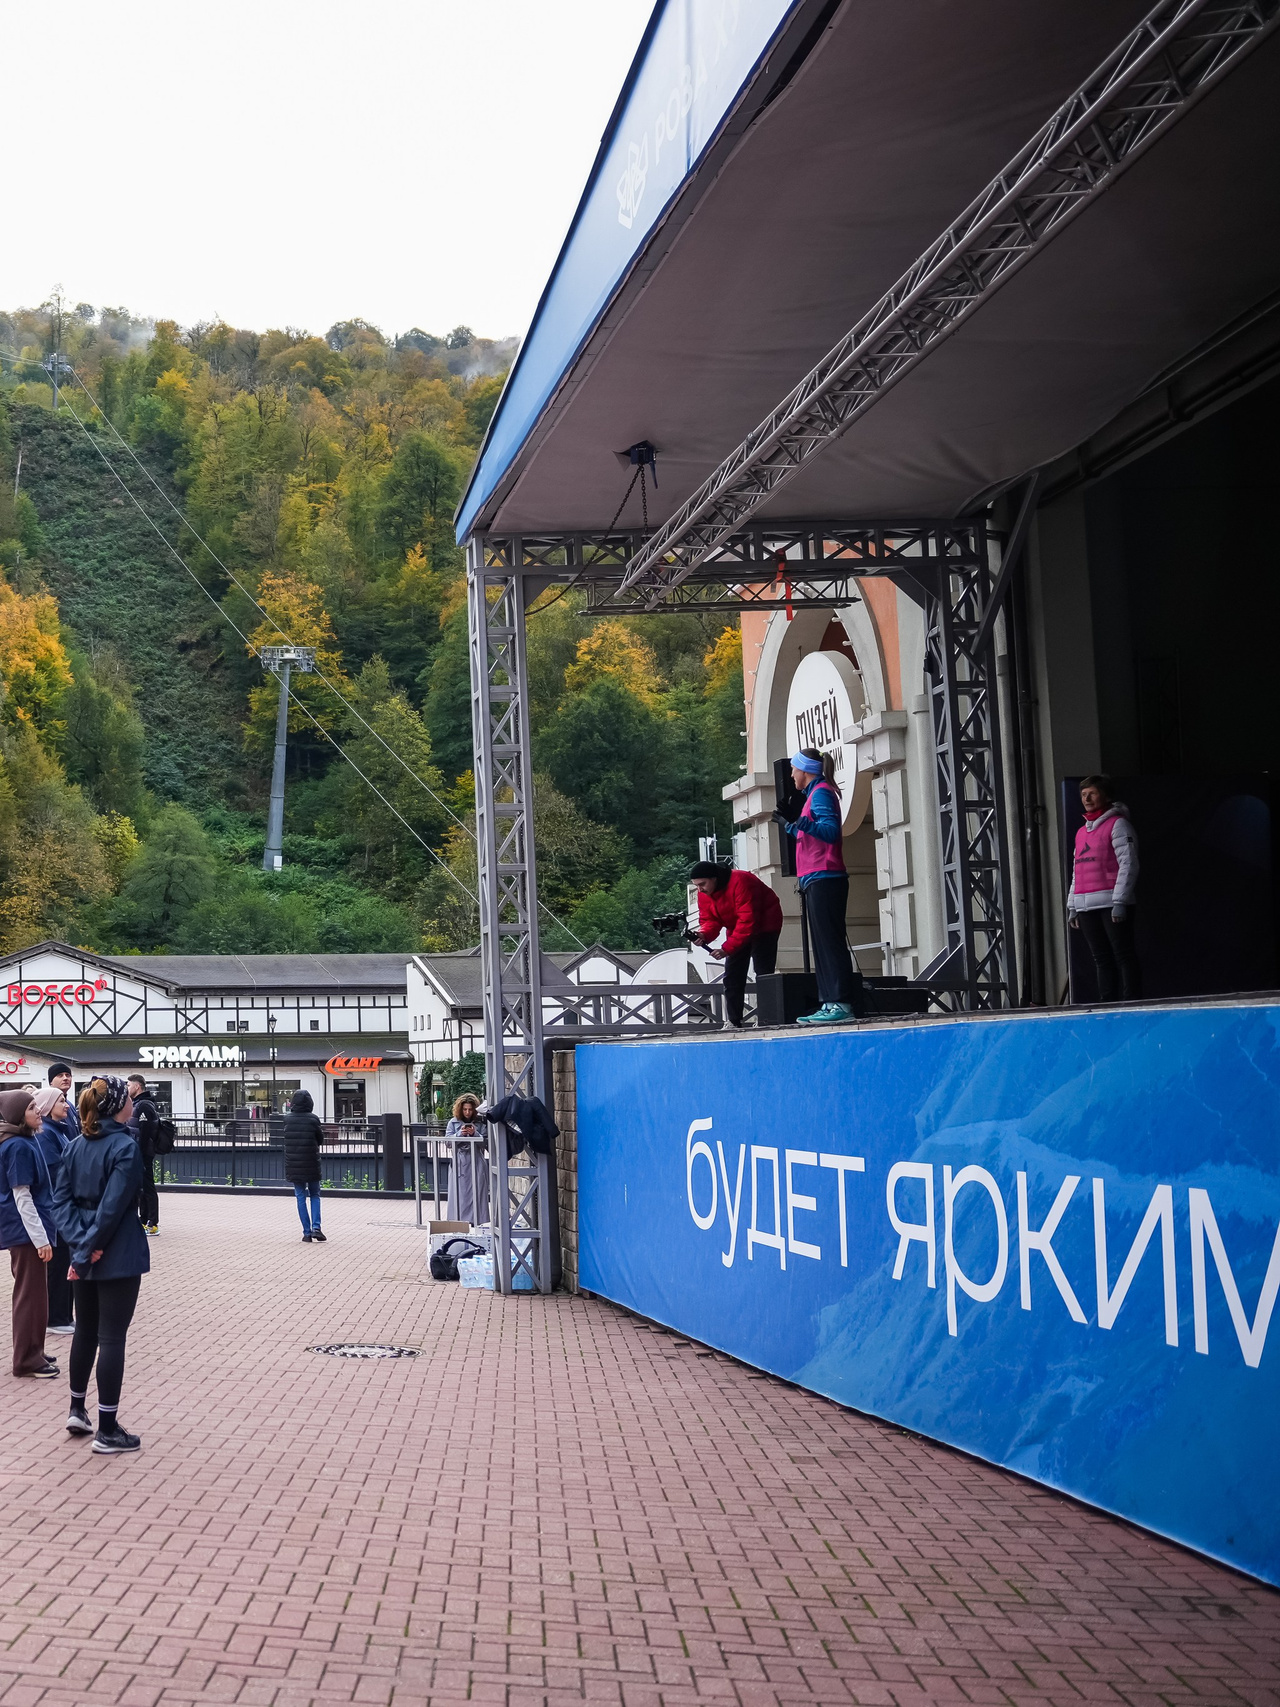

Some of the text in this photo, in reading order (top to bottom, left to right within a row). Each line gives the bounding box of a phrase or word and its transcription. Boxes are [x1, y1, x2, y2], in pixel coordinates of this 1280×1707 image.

[796, 688, 840, 751] МУЗЕЙ
[7, 984, 96, 1006] BOSCO
[138, 1045, 240, 1069] SPORTALM
